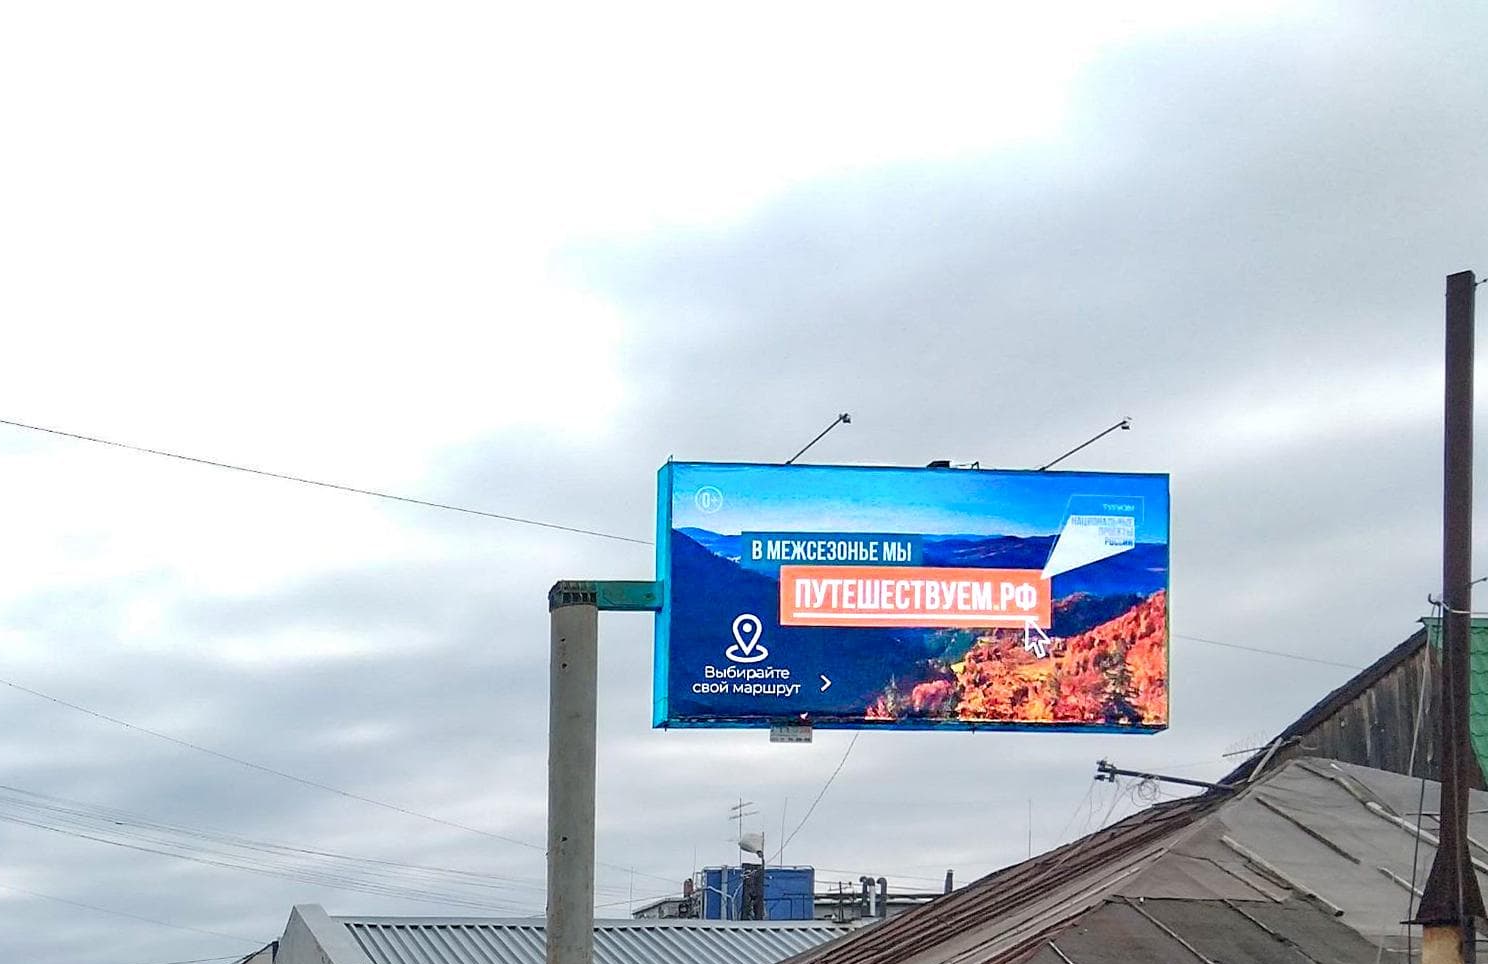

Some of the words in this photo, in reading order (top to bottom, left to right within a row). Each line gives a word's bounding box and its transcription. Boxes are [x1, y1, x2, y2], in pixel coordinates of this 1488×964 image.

[751, 539, 763, 560] В
[766, 539, 879, 562] МЕЖСЕЗОНЬЕ
[883, 541, 912, 562] МЫ
[794, 578, 1038, 611] ПУТЕШЕСТВУЕМ.РФ
[704, 665, 791, 681] Выбирайте
[692, 681, 729, 694] свой
[732, 682, 801, 697] маршрут
